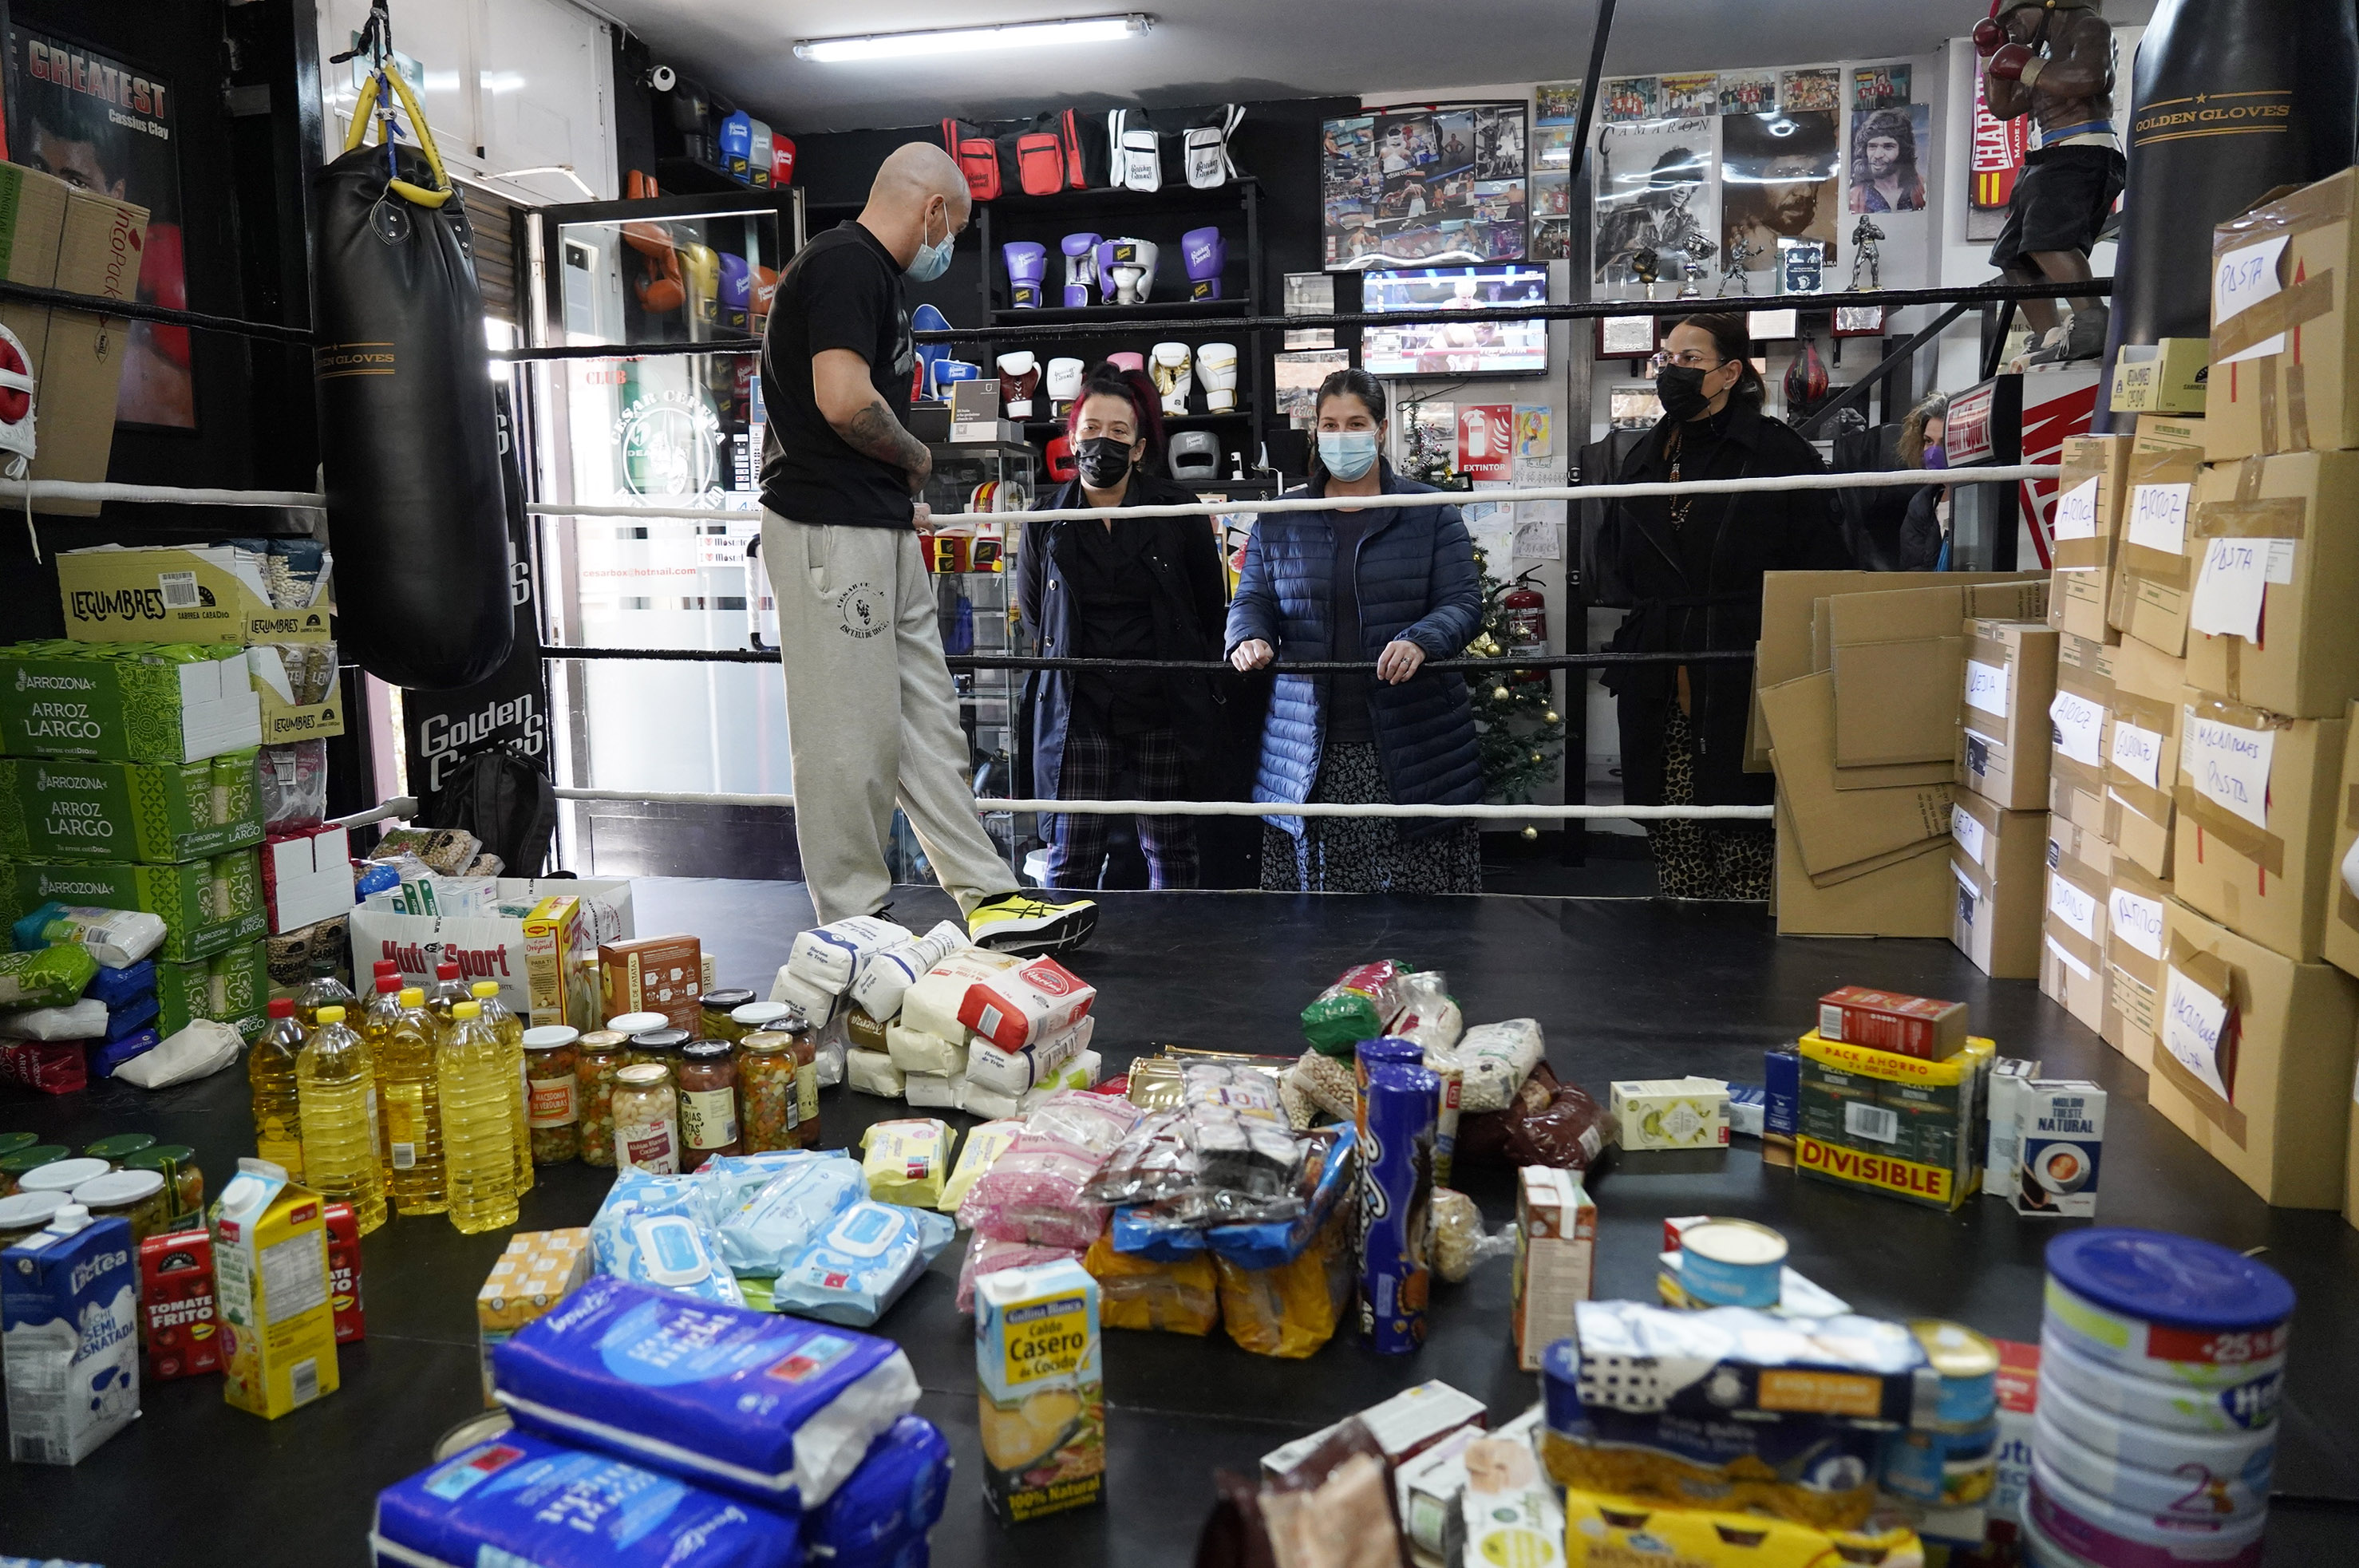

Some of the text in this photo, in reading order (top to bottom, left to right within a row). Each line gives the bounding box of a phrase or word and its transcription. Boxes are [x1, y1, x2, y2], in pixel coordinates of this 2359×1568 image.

[29, 39, 166, 120] GREATEST
[109, 109, 169, 140] Cassius Clay
[2136, 104, 2290, 132] GOLDEN GLOVES
[336, 353, 395, 365] GLOVES
[587, 369, 627, 385] CLUB
[1464, 464, 1506, 472] EXTINTOR
[70, 589, 167, 622] LEGUMBRES
[251, 618, 298, 634] LEGUMBRES
[26, 676, 93, 691] ARROZONA
[32, 702, 90, 718] ARROZ
[26, 720, 101, 740] LARGO
[275, 715, 315, 733] LEGUMBRES
[421, 693, 533, 758] Golden
[46, 776, 103, 790] ARROZONA
[51, 801, 103, 817] ARROZ
[45, 818, 113, 839] LARGO
[235, 820, 255, 831] ARROZ
[228, 826, 261, 843] LARGO
[49, 882, 109, 896] ARROZONA
[235, 918, 266, 938] LARGO
[526, 942, 555, 954] Original
[809, 946, 828, 958] Harina
[813, 953, 828, 965] Trigo
[183, 975, 209, 987] LARGO
[1026, 971, 1062, 993] Harina
[632, 986, 638, 998] DE
[984, 1050, 1005, 1063] Harina
[990, 1059, 1006, 1069] Trigo
[1825, 1046, 1929, 1076] PACK AHORRO
[535, 1092, 567, 1101] MACEDONIA
[539, 1100, 568, 1110] VERDURAS
[2037, 1117, 2095, 1134] NATURAL
[1802, 1136, 1942, 1196] DIVISIBLE
[148, 1295, 213, 1315] TOMATE
[152, 1306, 214, 1329] FRITO
[83, 1317, 117, 1343] SEMI
[1028, 1320, 1064, 1337] Caldo
[1010, 1333, 1085, 1361] Casero
[1033, 1357, 1079, 1376] Cocido
[1007, 1491, 1048, 1513] 100%
[1049, 1478, 1100, 1503] Natural
